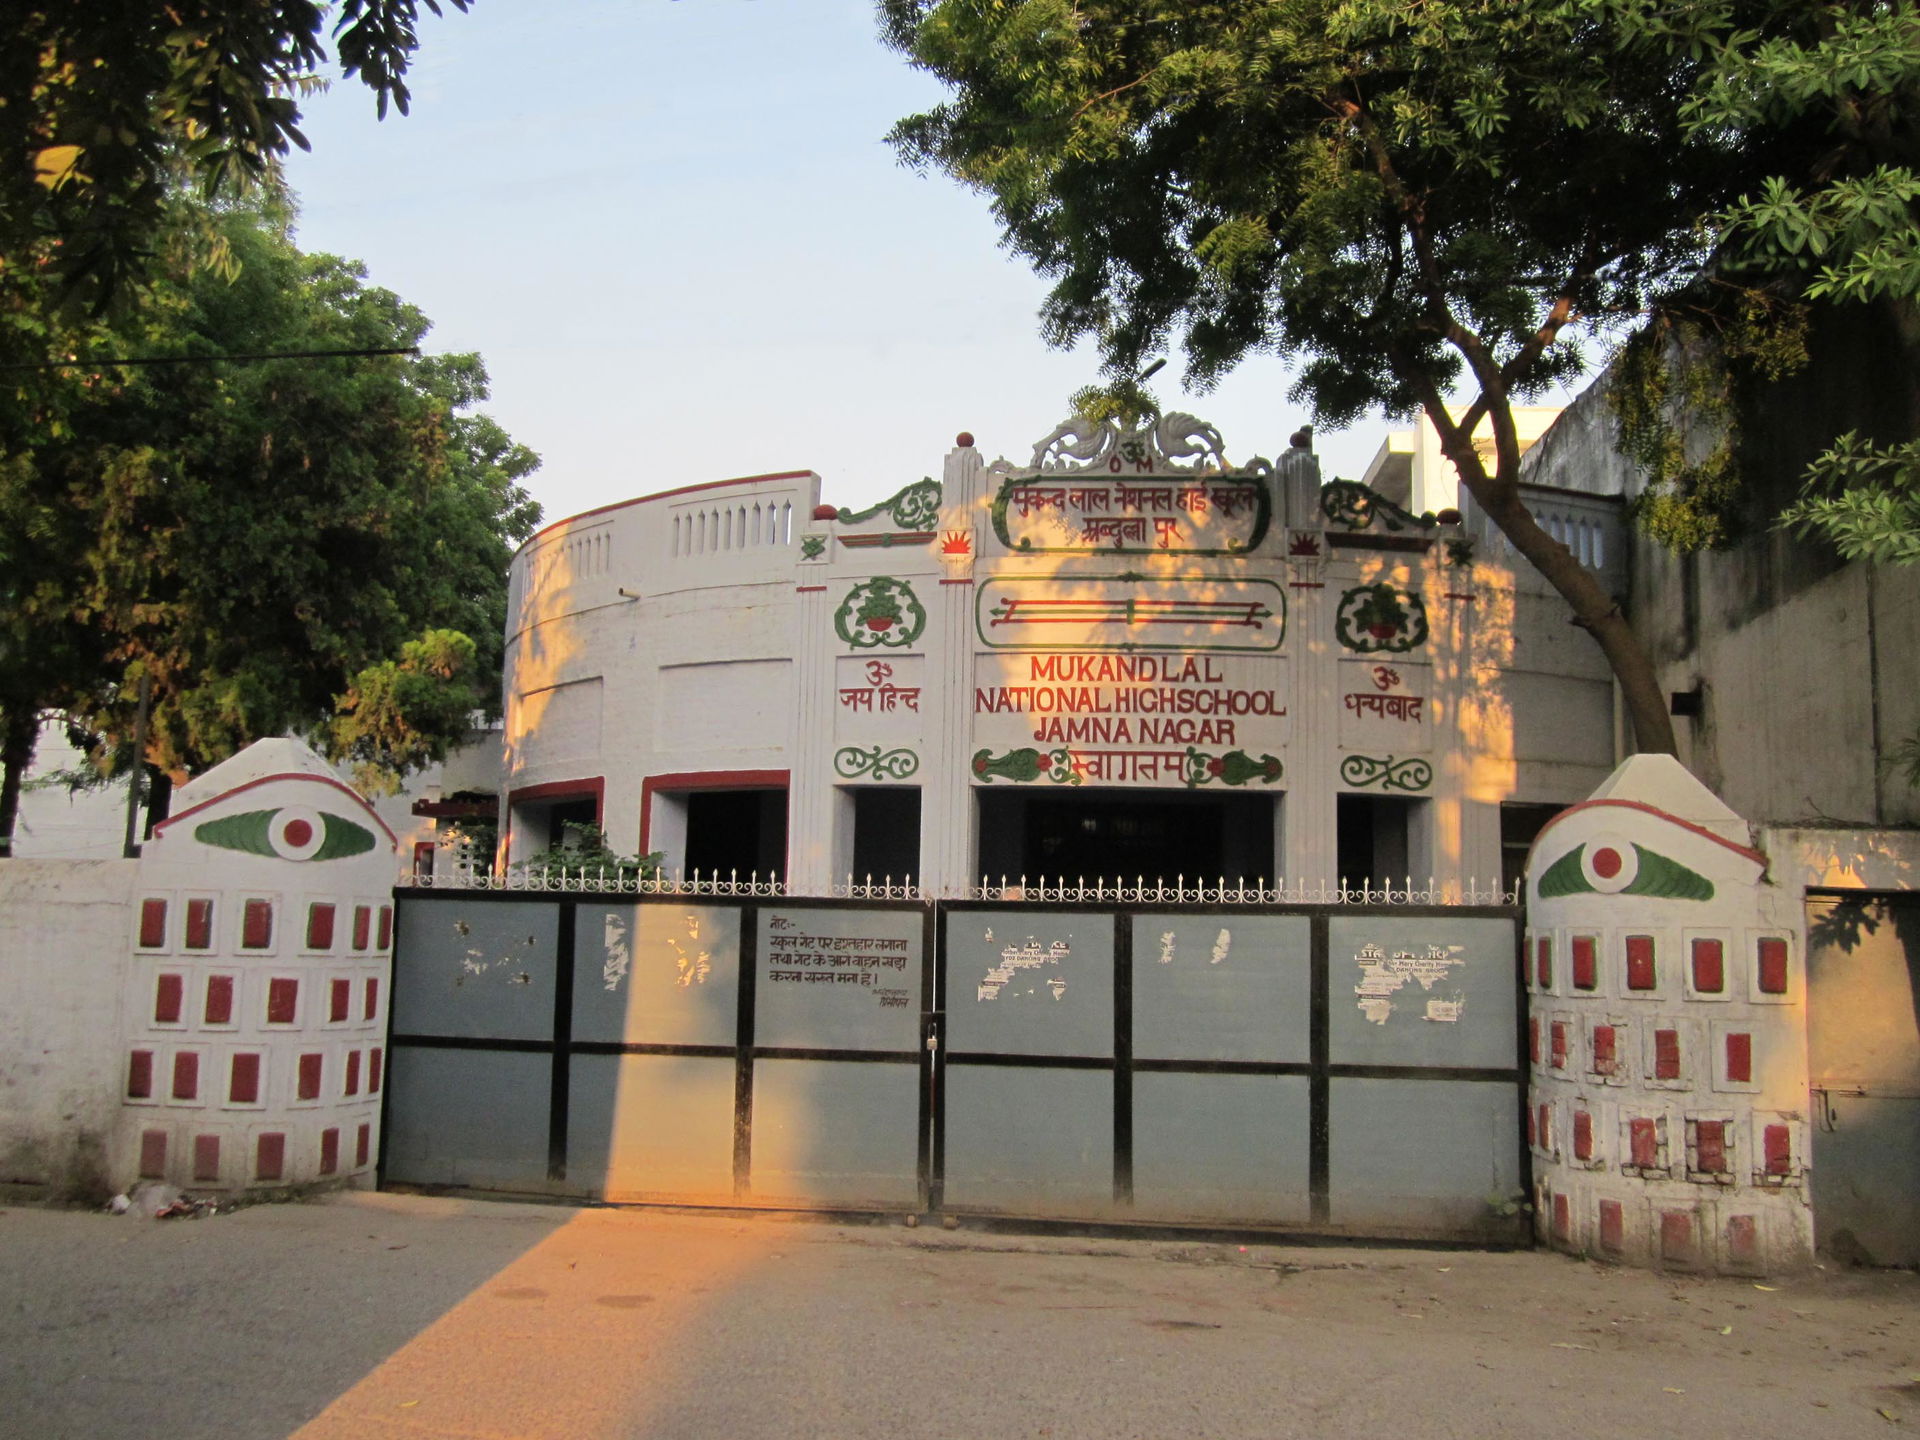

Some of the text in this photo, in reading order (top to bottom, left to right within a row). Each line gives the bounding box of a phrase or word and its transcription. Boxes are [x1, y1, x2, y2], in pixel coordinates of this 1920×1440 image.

[1069, 487, 1110, 513] लाल
[1114, 481, 1172, 513] नेशनल
[1176, 480, 1209, 513] हाई
[1211, 487, 1255, 520] स्कूल
[1152, 517, 1185, 549] पुर
[839, 682, 921, 713] जय हिन्द
[975, 687, 1112, 714] NATIONAL
[1033, 717, 1236, 745] JAMNA NAGAR
[770, 936, 798, 951] स्कूल
[817, 937, 834, 951] पर
[875, 938, 909, 952] लगाना
[769, 953, 792, 965] तथा
[813, 950, 827, 966] के
[827, 951, 851, 967] आगे
[852, 956, 881, 968] वाहन
[769, 970, 803, 982] करना
[837, 973, 859, 984] मना
